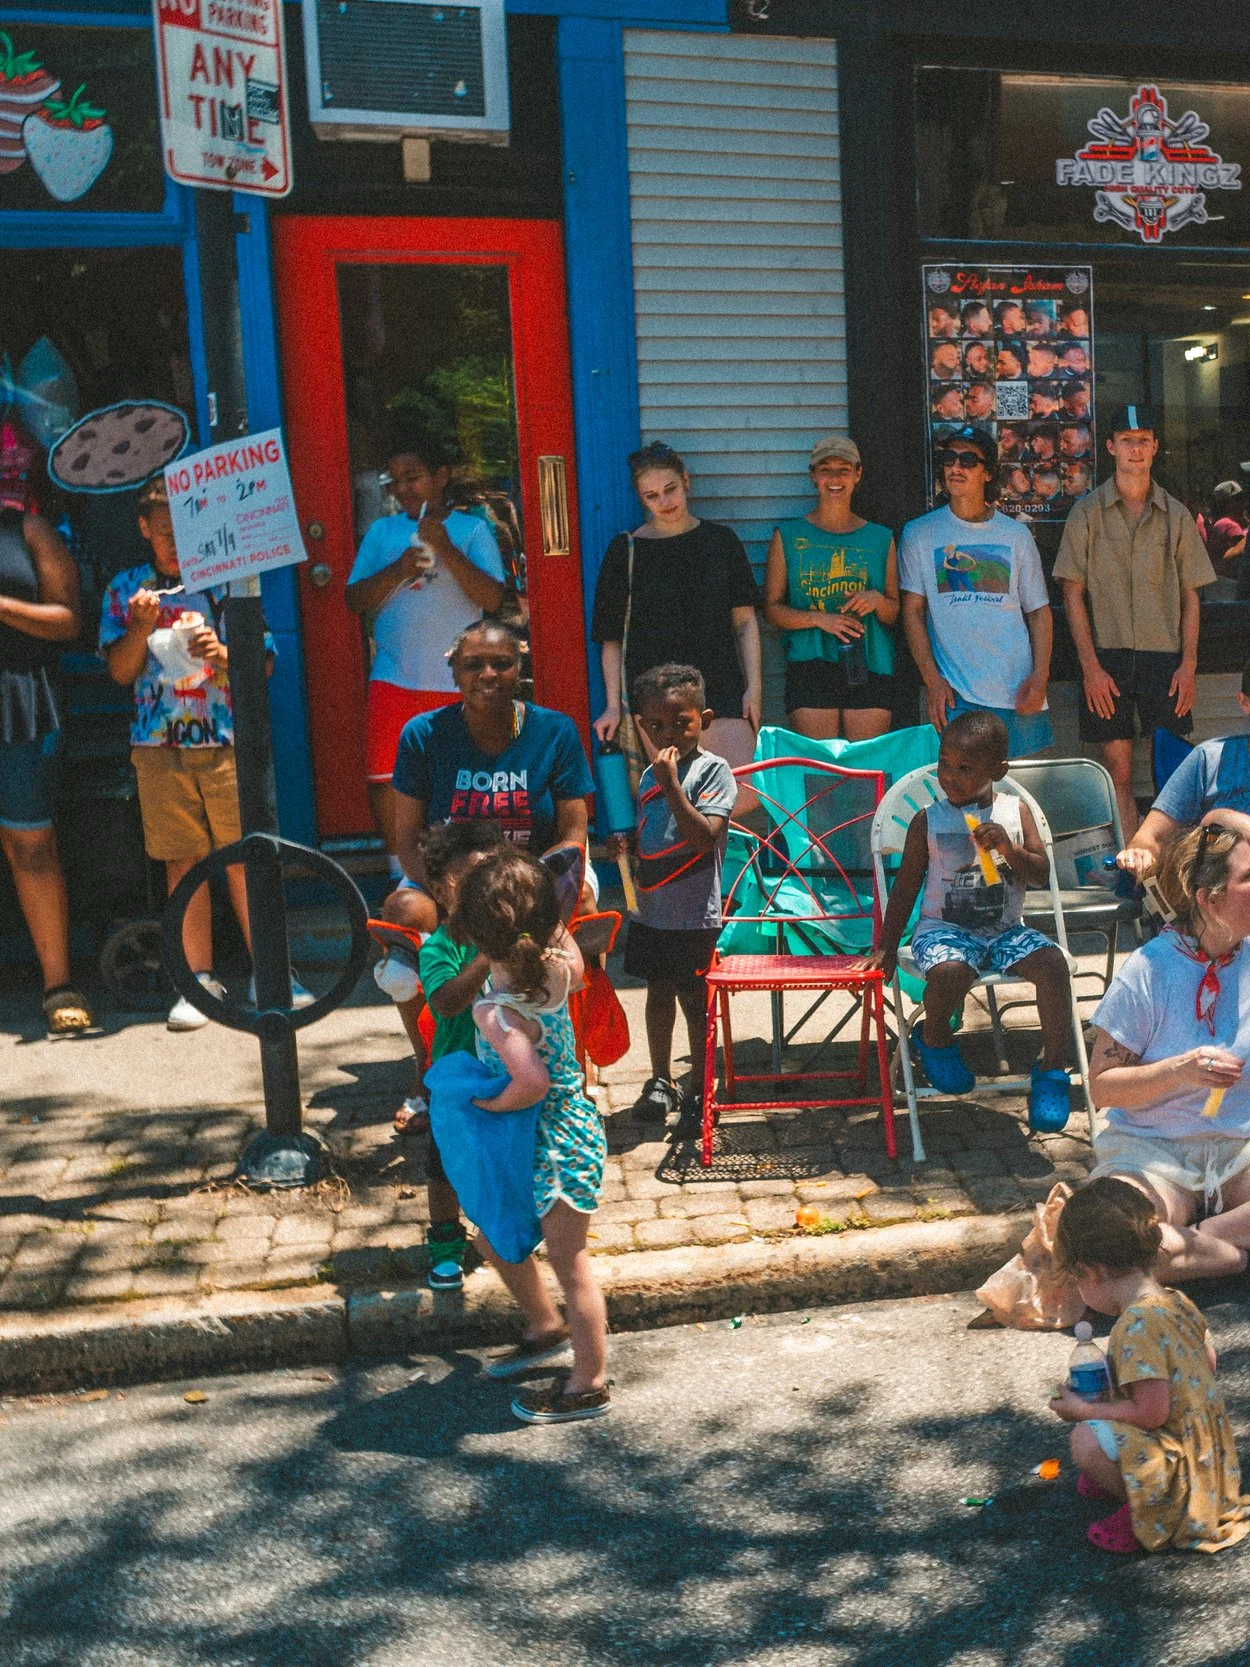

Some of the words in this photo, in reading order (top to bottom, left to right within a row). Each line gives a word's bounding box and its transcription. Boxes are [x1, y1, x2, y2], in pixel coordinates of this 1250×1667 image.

[208, 2, 269, 36] PARKING
[189, 42, 256, 89] ANY
[202, 151, 224, 168] TOW
[1056, 158, 1135, 186] FADE
[1144, 160, 1242, 190] KINGZ
[1130, 186, 1169, 194] QUALITY
[1171, 187, 1197, 195] CUTS
[167, 468, 191, 497] NO
[193, 438, 280, 487] PARKING
[190, 555, 247, 582] CINCINNATI
[250, 543, 291, 564] POLICE
[166, 718, 220, 746] ICON
[455, 769, 528, 792] BORN
[450, 789, 531, 816] FREE
